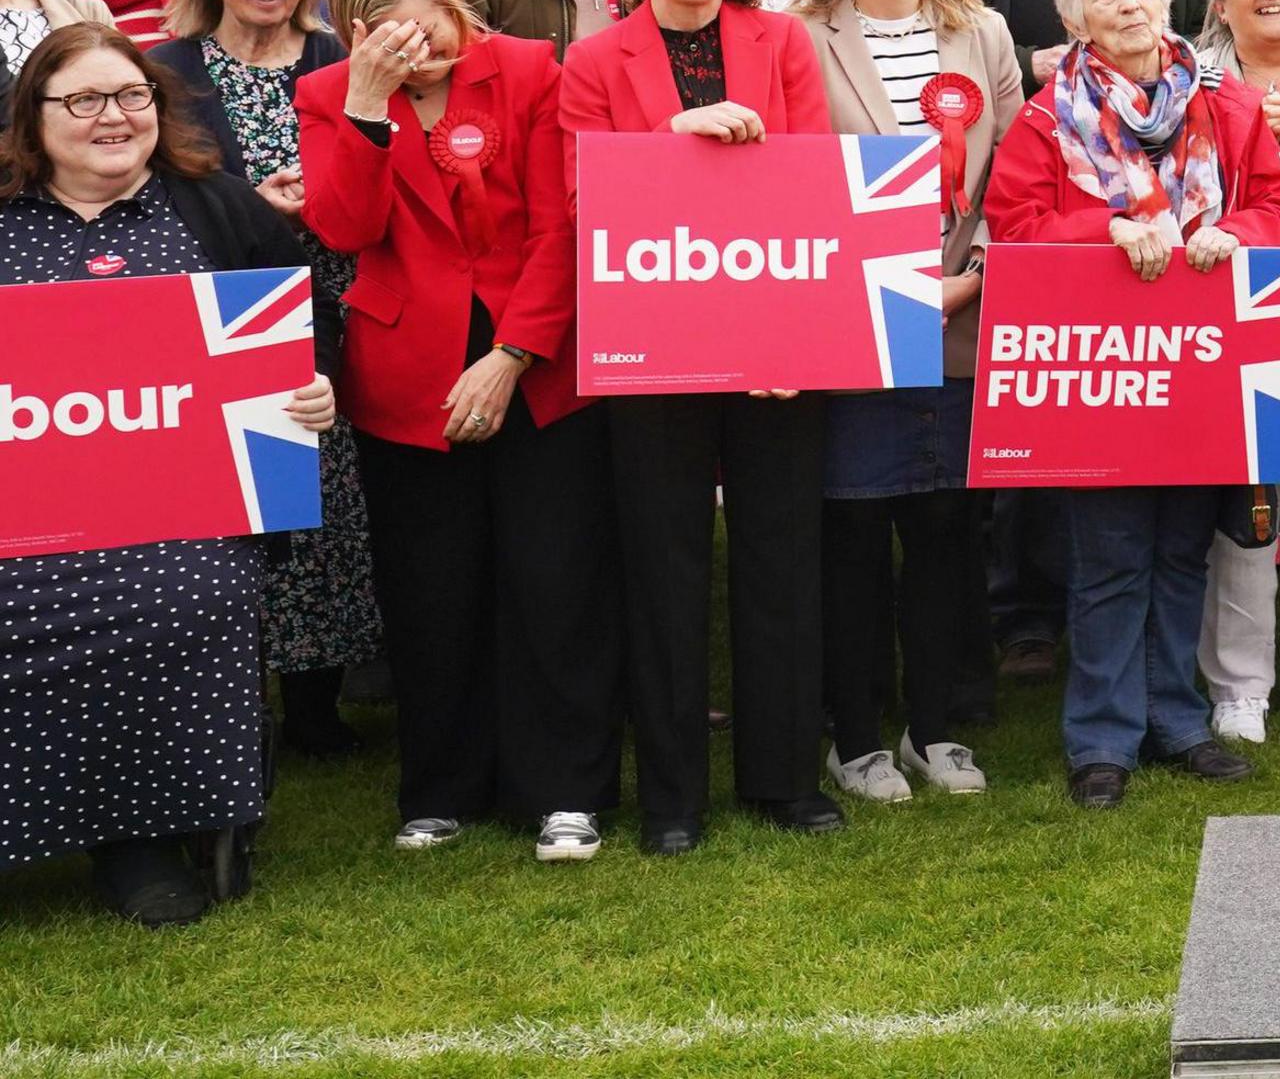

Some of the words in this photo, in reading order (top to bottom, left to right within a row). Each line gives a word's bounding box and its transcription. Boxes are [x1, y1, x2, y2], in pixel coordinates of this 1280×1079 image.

[592, 225, 840, 283] Labour
[603, 351, 646, 364] Labour
[991, 325, 1224, 363] BRITAIN'S
[986, 370, 1172, 408] FUTURE
[993, 447, 1032, 459] Labour
